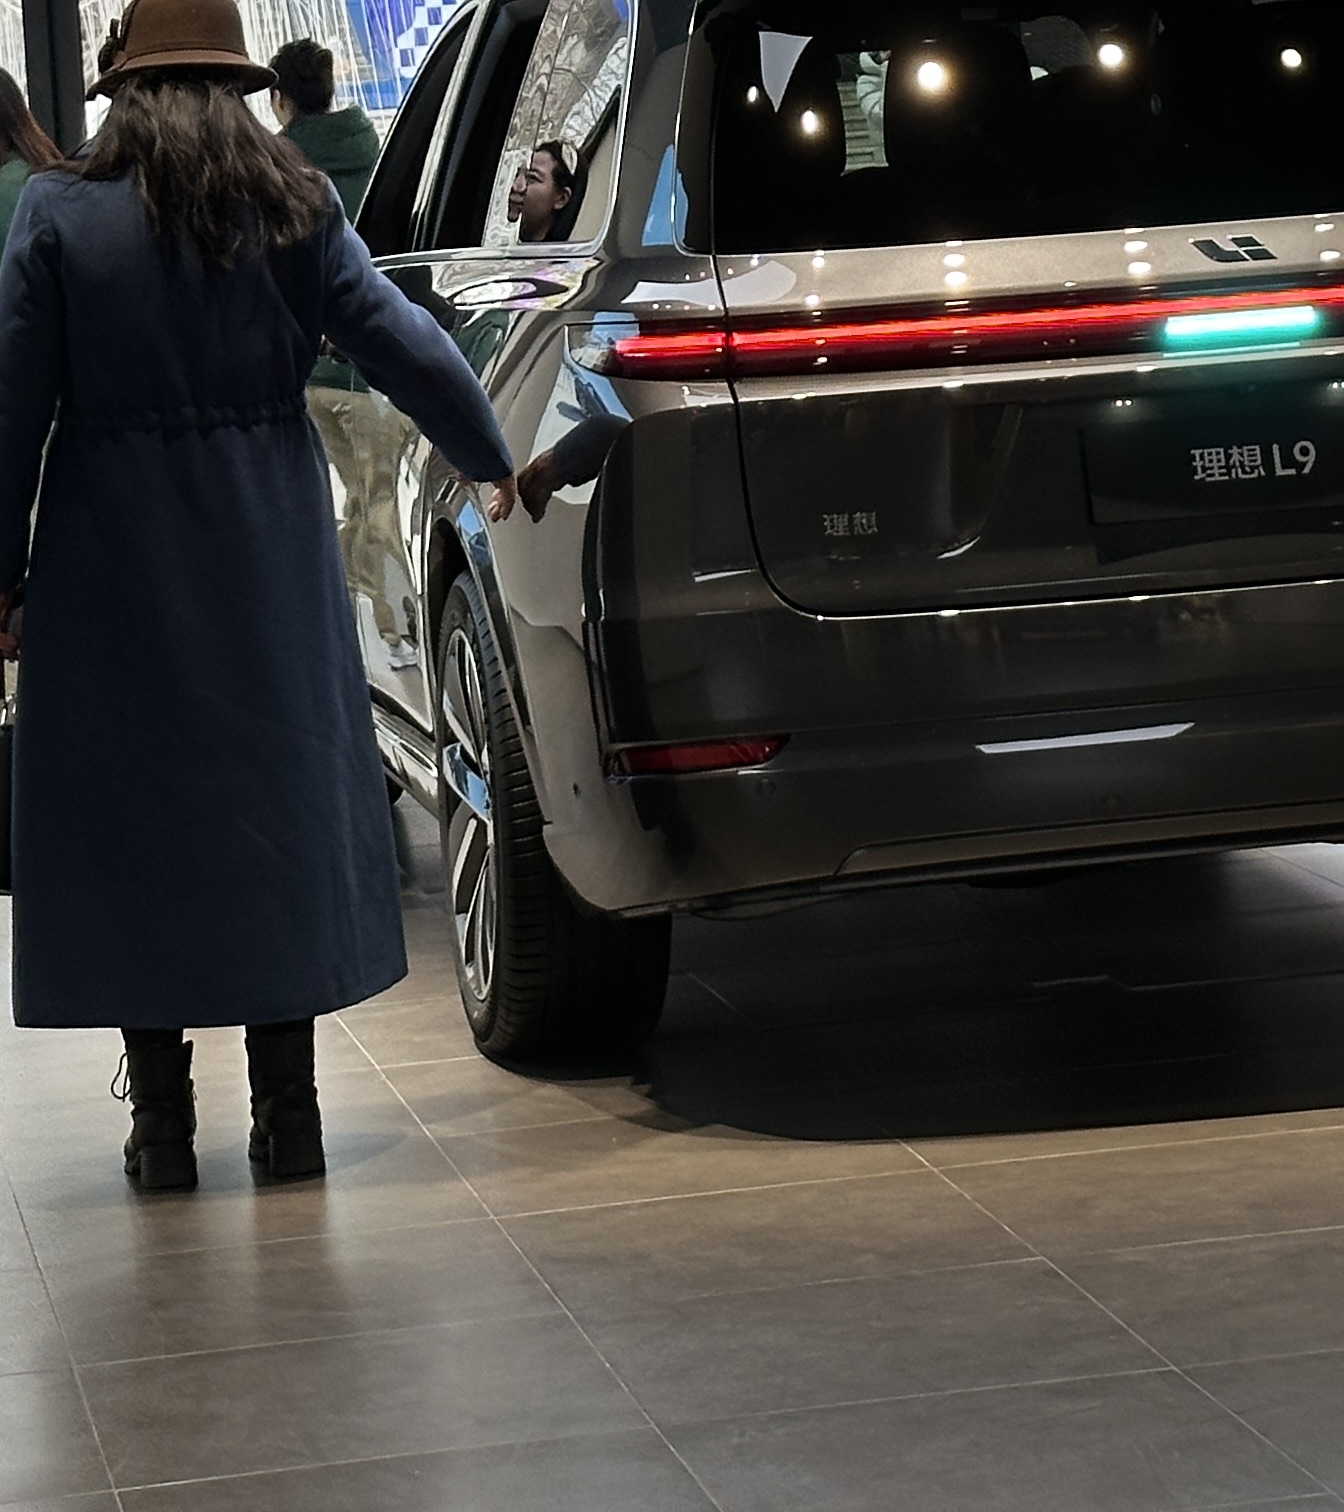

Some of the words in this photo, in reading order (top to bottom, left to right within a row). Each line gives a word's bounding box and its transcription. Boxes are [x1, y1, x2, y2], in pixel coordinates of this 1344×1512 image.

[1191, 444, 1266, 483] 理想
[1272, 440, 1317, 477] L9
[821, 510, 879, 537] 理想
